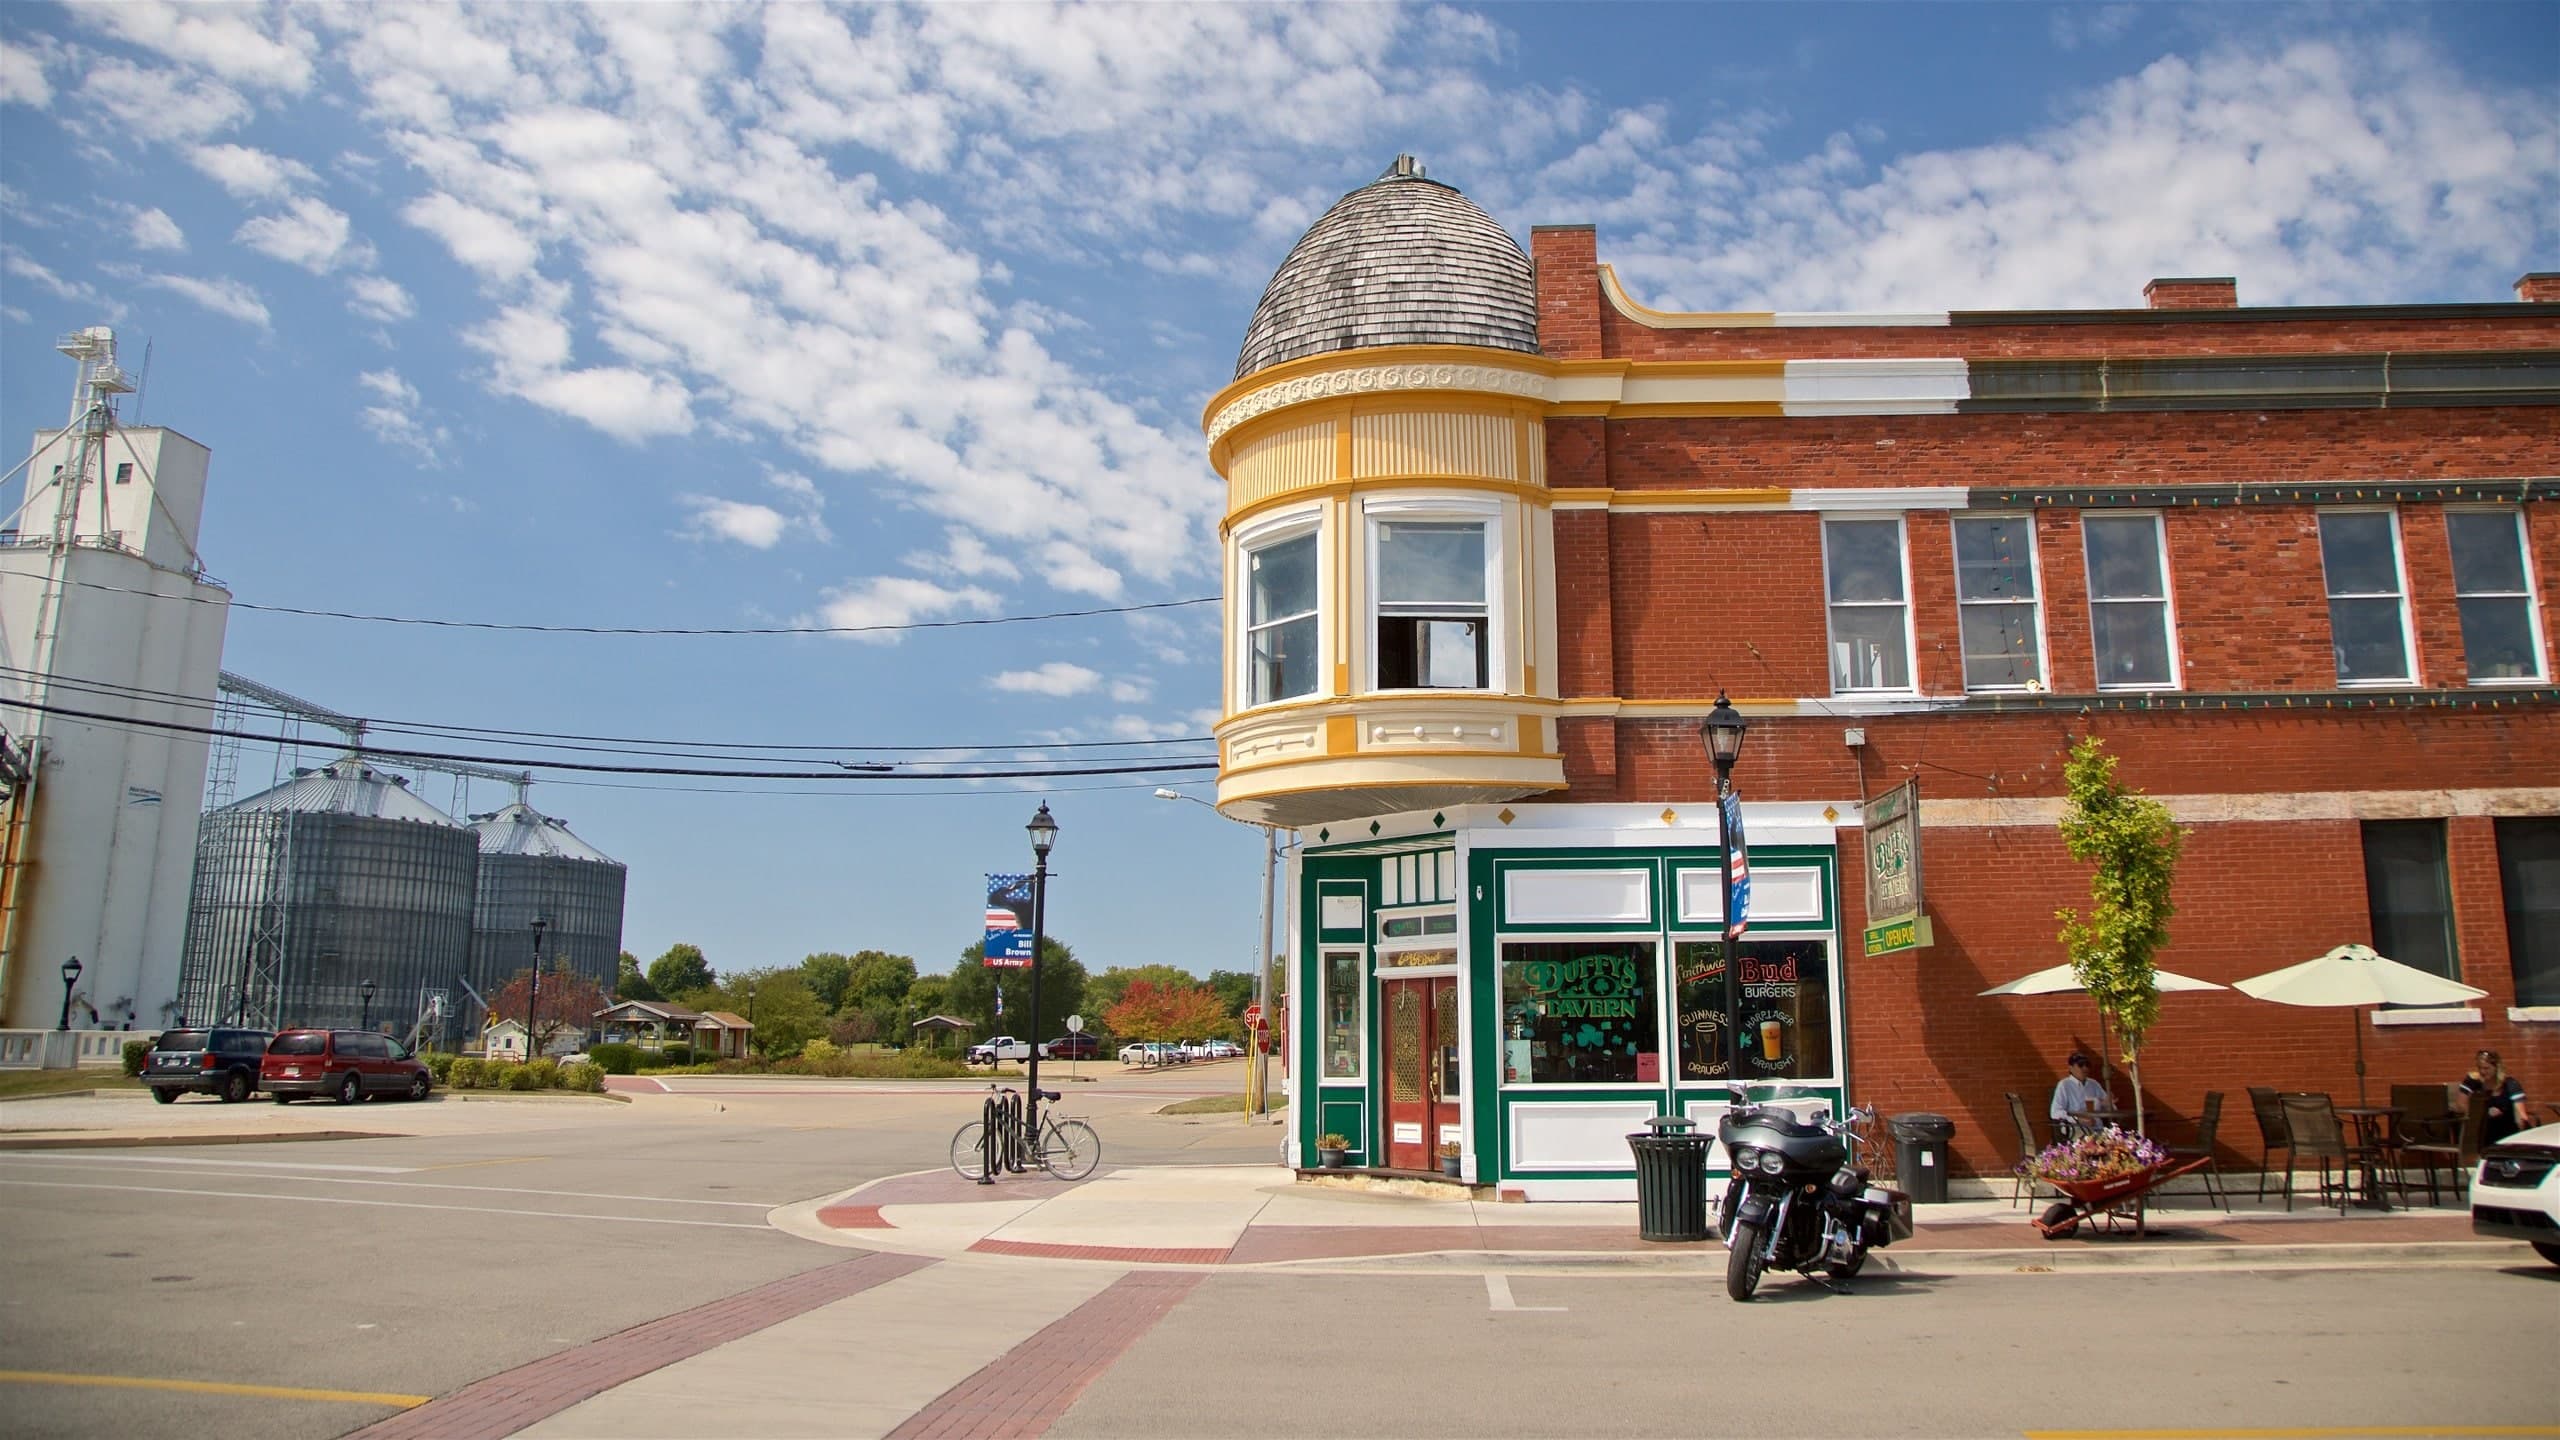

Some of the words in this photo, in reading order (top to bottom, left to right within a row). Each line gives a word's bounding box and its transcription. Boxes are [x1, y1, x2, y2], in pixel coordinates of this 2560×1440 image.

[1018, 940, 1032, 948] Bill
[1886, 929, 1902, 947] OPEN
[1005, 948, 1032, 956] Brown
[1004, 959, 1024, 967] Army
[1739, 956, 1798, 983] Bud
[1524, 955, 1637, 994] DUFFY'S
[1676, 958, 1726, 987] Smithwic
[1745, 986, 1797, 998] BURGERS
[1546, 998, 1637, 1019] TAVERN
[1246, 1013, 1261, 1023] STO
[1744, 1010, 1766, 1030] HARP
[1688, 1061, 1730, 1075] DRAUGHT
[1752, 1054, 1796, 1071] DRAUGHT
